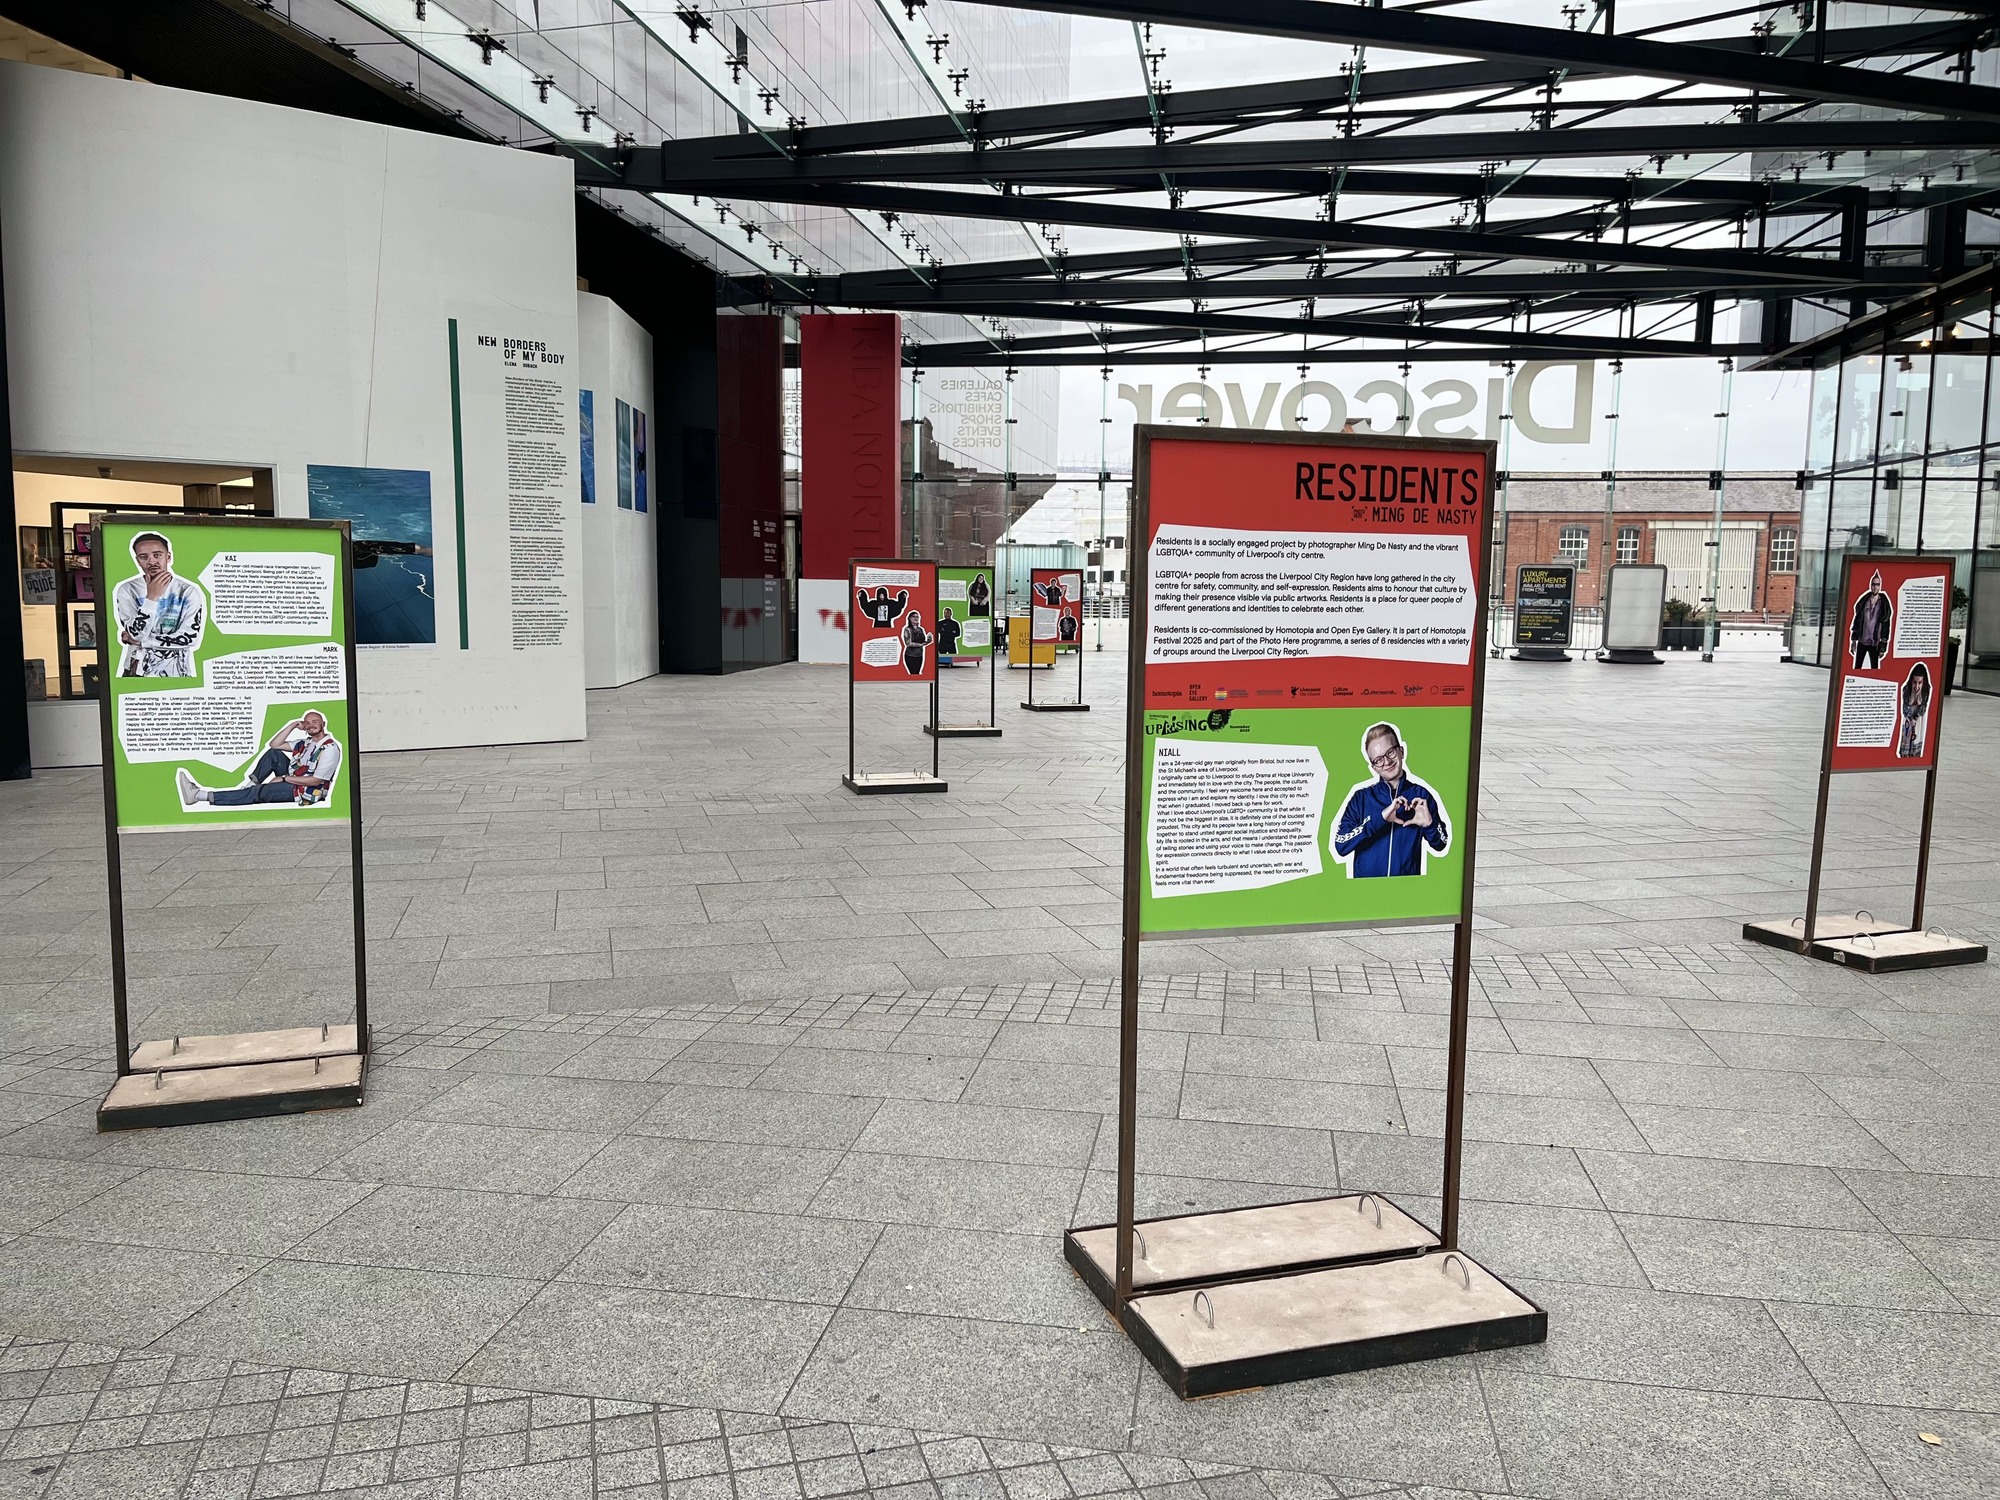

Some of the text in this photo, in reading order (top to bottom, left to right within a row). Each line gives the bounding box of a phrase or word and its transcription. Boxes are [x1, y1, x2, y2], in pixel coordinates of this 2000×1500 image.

[478, 336, 546, 352] NEW BORDERS
[504, 349, 564, 364] OF MY BODY
[852, 327, 882, 420] RIBA
[1295, 462, 1478, 505] RESIDENTS
[1372, 507, 1404, 522] MING
[1413, 508, 1429, 523] DE
[1437, 508, 1477, 524] NASTY
[1209, 539, 1235, 548] socially
[1237, 540, 1269, 548] engaged
[1271, 540, 1296, 549] project
[1298, 540, 1306, 549] by
[1308, 541, 1356, 550] photographer
[1358, 542, 1374, 551] Ming
[1388, 542, 1407, 551] Nasty
[1156, 548, 1193, 557] LGBTQIA+
[1195, 550, 1235, 559] community
[1247, 550, 1284, 559] Liverpool's
[1286, 551, 1300, 560] city
[1156, 570, 1192, 579] LGBTQIA+
[1194, 572, 1220, 580] people
[1222, 571, 1238, 579] from
[1280, 573, 1312, 581] Liverpool
[1314, 573, 1328, 582] City
[1330, 573, 1354, 582] Region
[1374, 574, 1389, 583] long
[1391, 574, 1421, 583] gathered
[1443, 576, 1456, 584] city
[26, 577, 56, 594] PRIDE
[1193, 582, 1216, 591] safety,
[1218, 583, 1259, 592] community,
[1276, 583, 1330, 592] self-expression.
[1459, 586, 1467, 594] by
[1265, 626, 1274, 635] by
[1276, 626, 1314, 635] Homotopia
[1331, 626, 1350, 635] Open
[1352, 627, 1364, 635] Eye
[1366, 627, 1391, 635] Gallery.
[1430, 627, 1466, 635] Homotopia
[1448, 638, 1470, 646] variety
